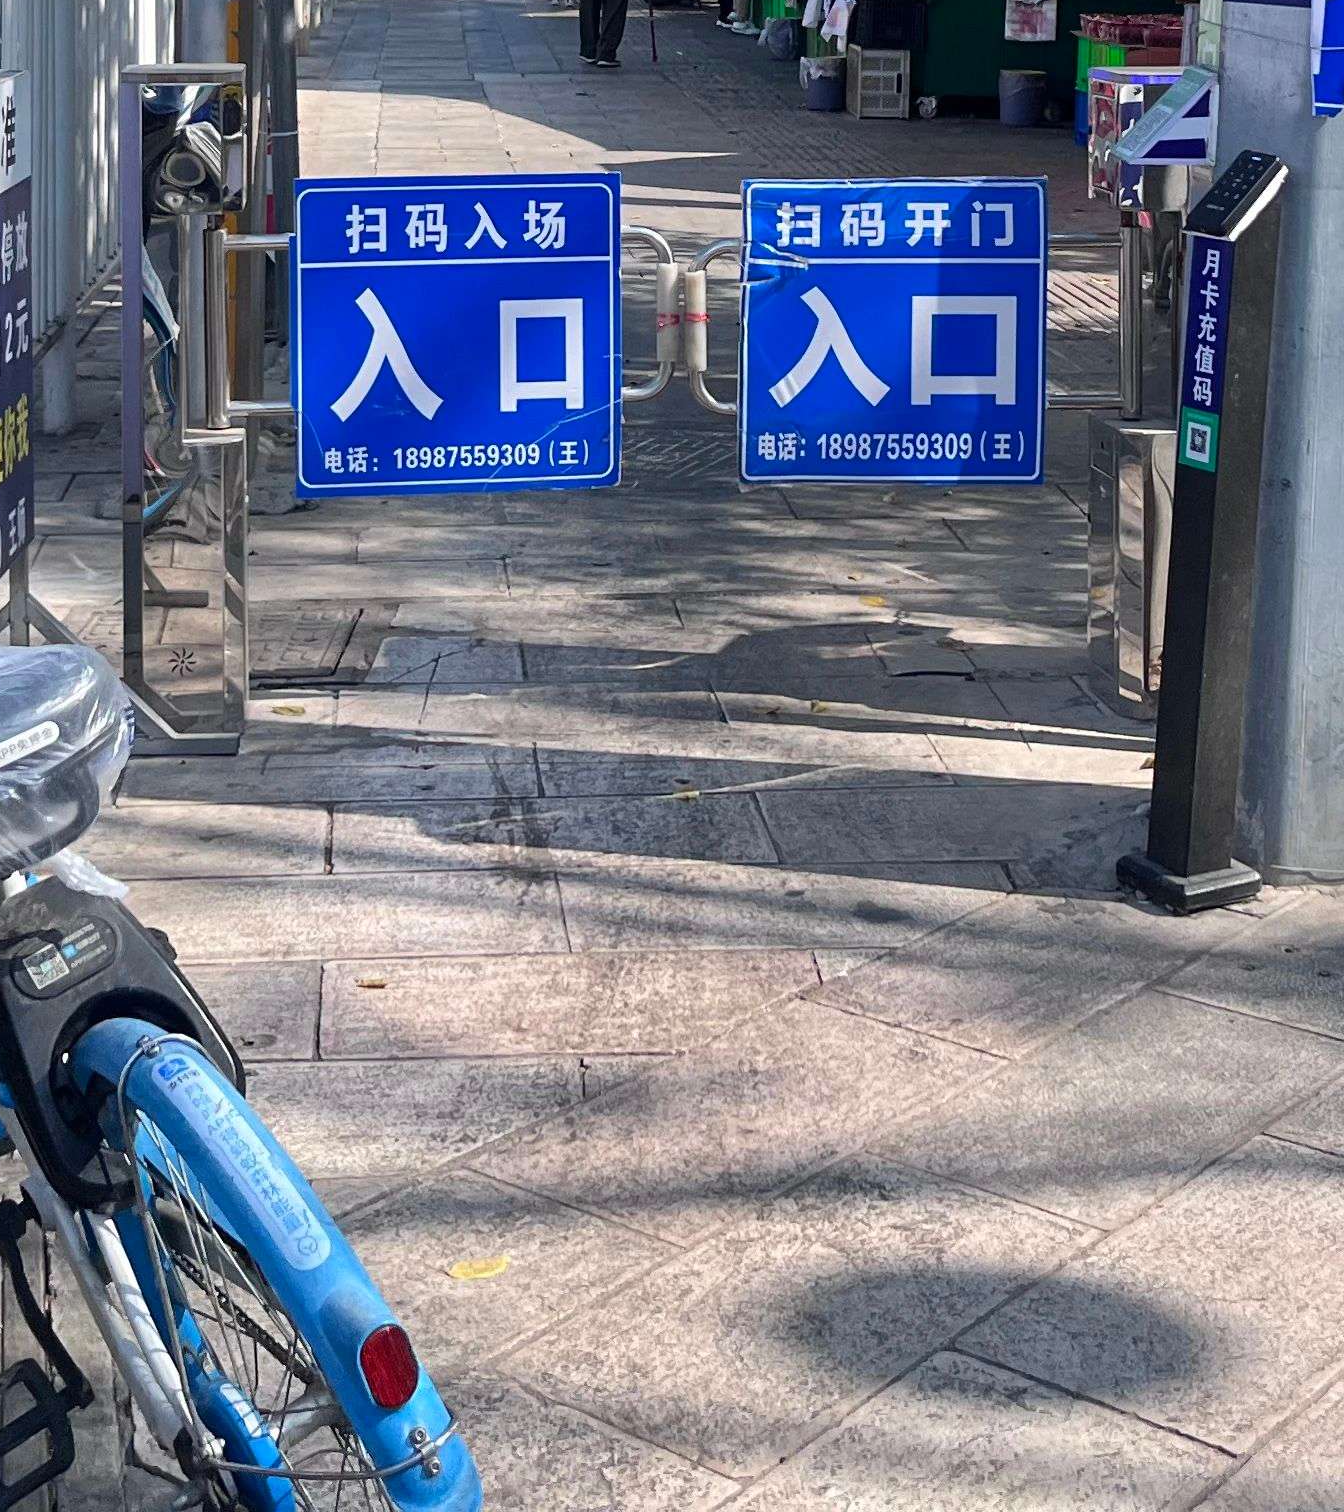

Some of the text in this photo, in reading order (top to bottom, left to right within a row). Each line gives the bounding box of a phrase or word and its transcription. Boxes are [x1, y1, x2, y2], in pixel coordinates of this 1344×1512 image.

[345, 199, 566, 254] 扫码入场
[776, 200, 1014, 248] 扫码开门
[330, 287, 584, 423] 入口
[768, 286, 1017, 408] 入口
[1192, 248, 1220, 407] 月卡充值码
